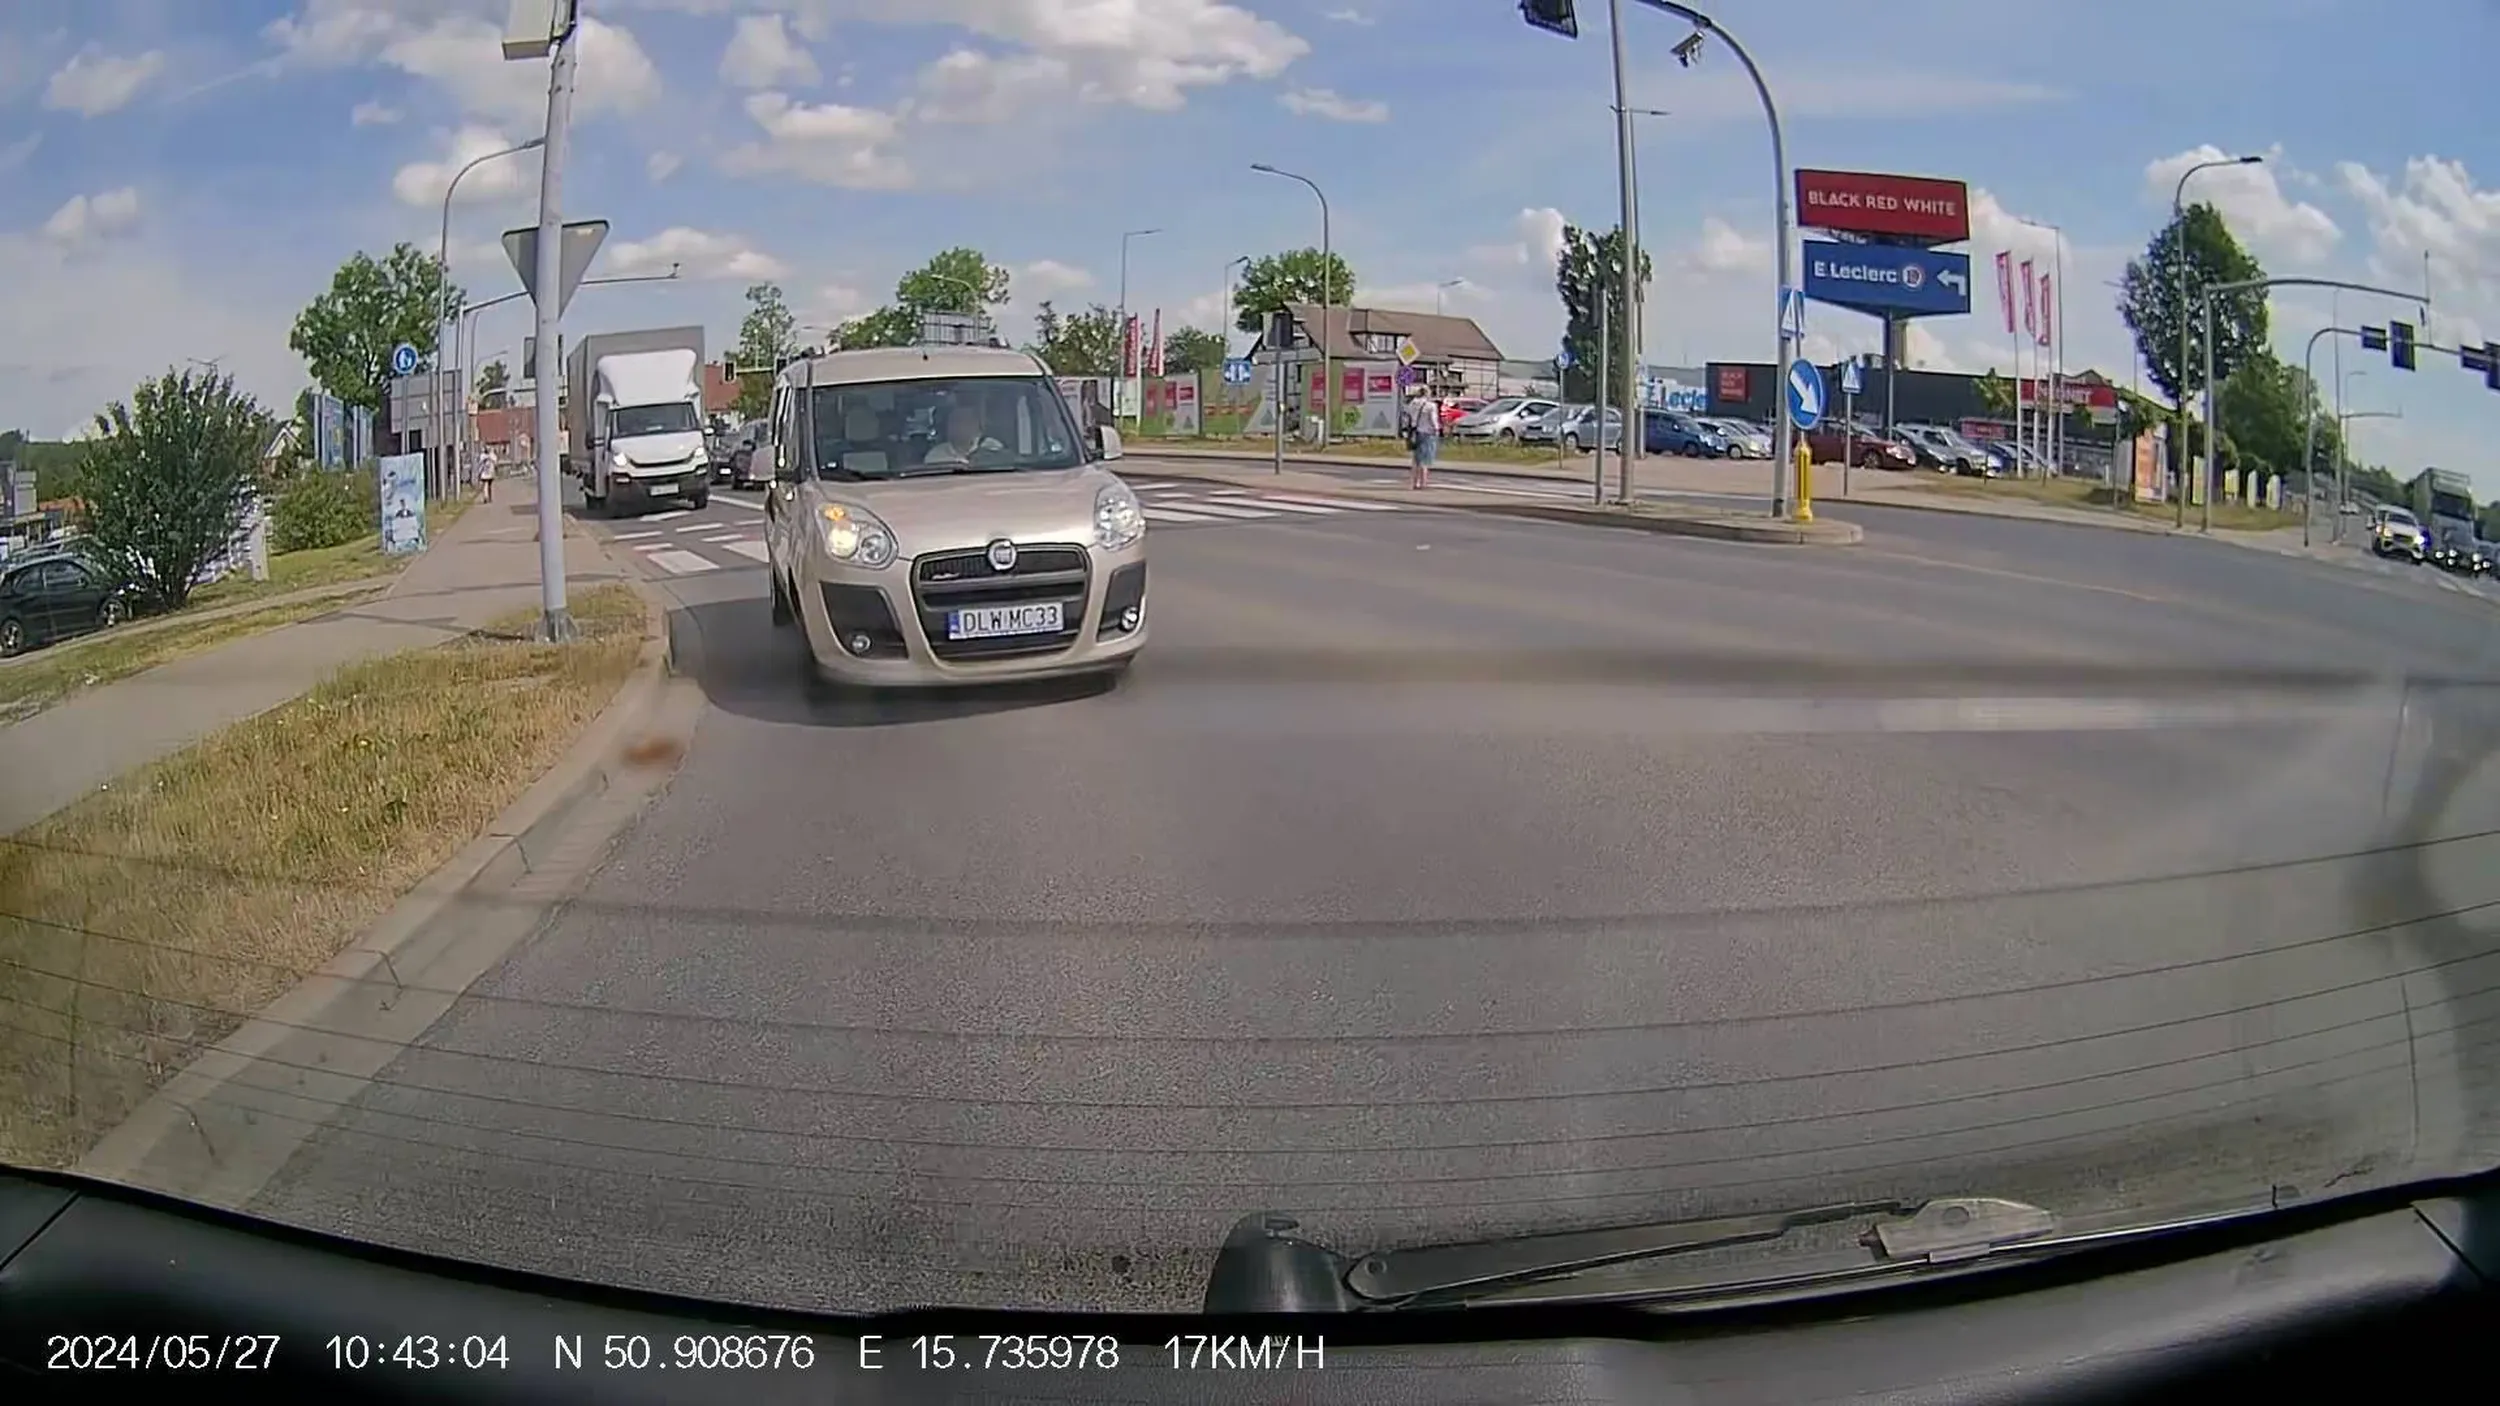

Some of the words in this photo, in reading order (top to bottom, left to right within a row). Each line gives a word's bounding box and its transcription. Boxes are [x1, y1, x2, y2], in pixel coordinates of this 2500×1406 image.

[1807, 190, 1861, 208] BLACK
[1866, 195, 1898, 211] RED
[1904, 198, 1956, 216] WHITE
[963, 610, 1002, 632] DLW
[1009, 606, 1058, 629] MC33
